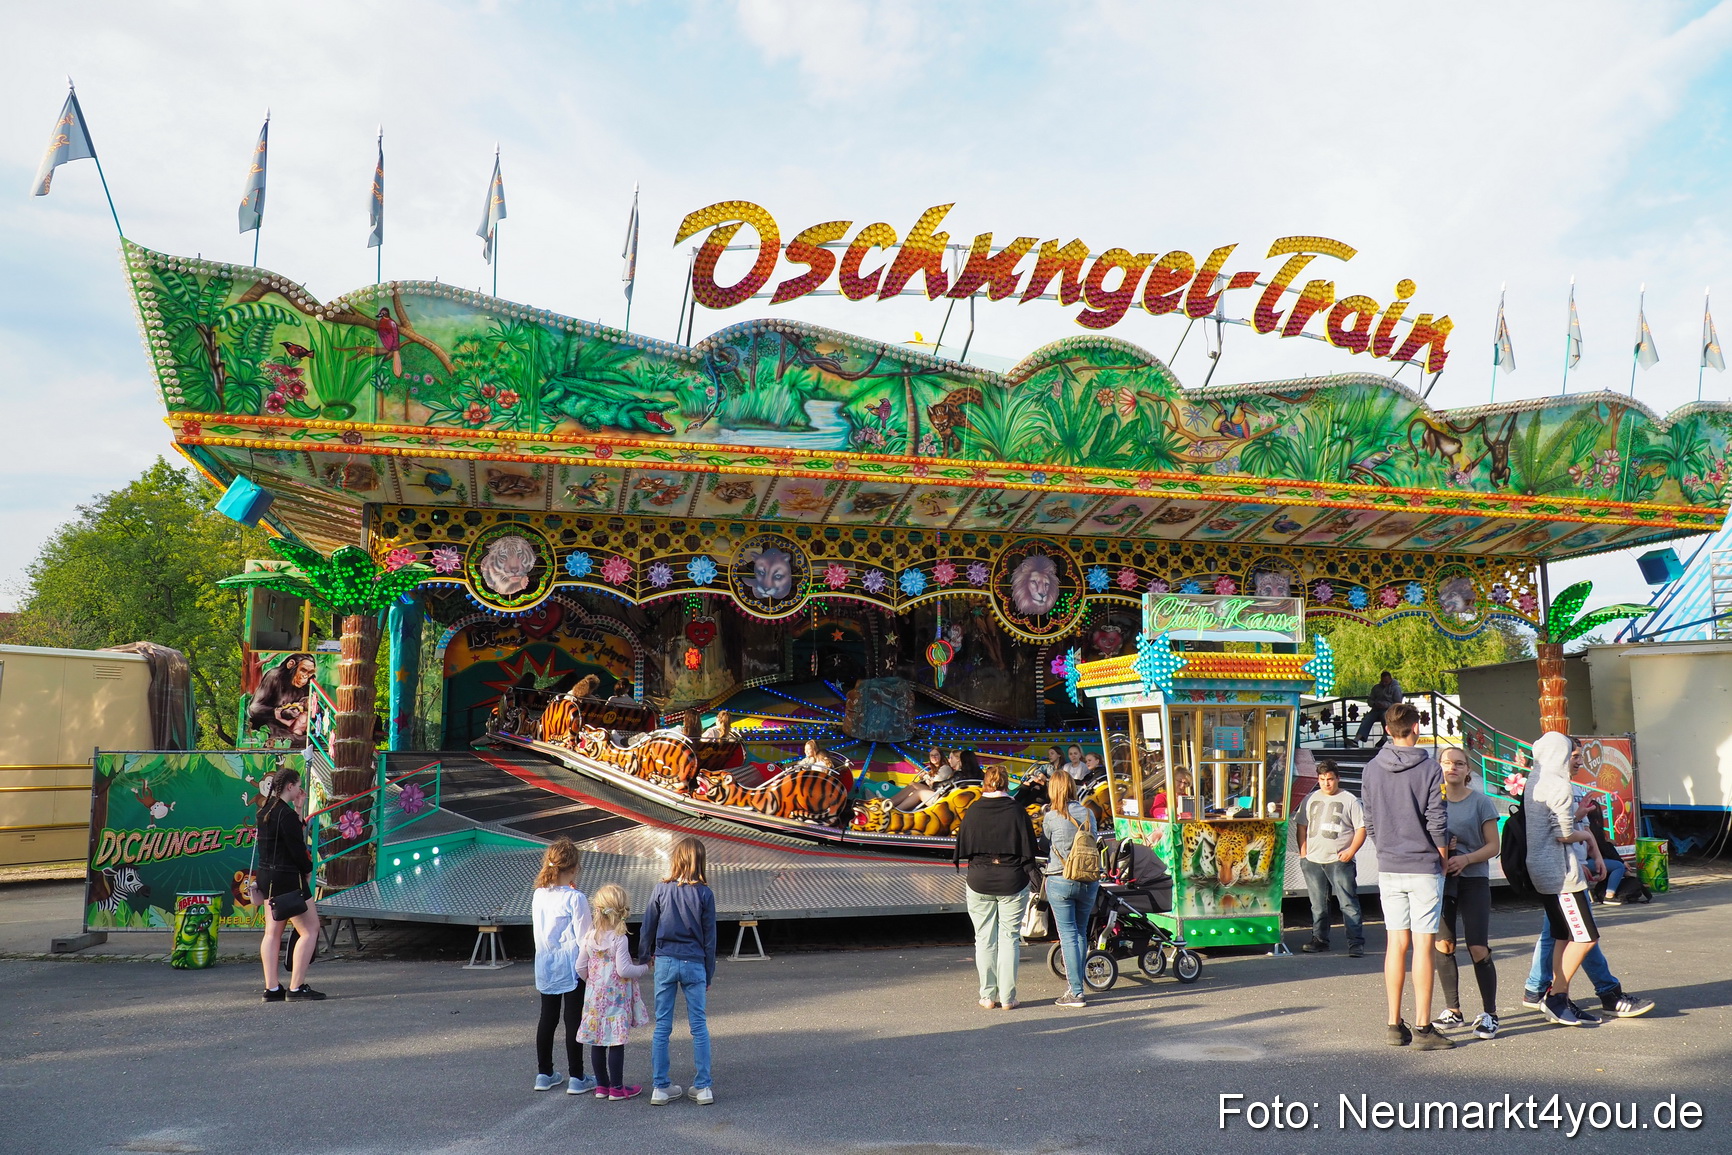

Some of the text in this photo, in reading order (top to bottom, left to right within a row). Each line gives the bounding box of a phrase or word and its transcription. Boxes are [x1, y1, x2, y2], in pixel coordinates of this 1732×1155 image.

[1150, 597, 1301, 639] Chip-Kasse
[96, 827, 258, 866] DSCHUNGEL-TR
[178, 895, 210, 912] ABFALL
